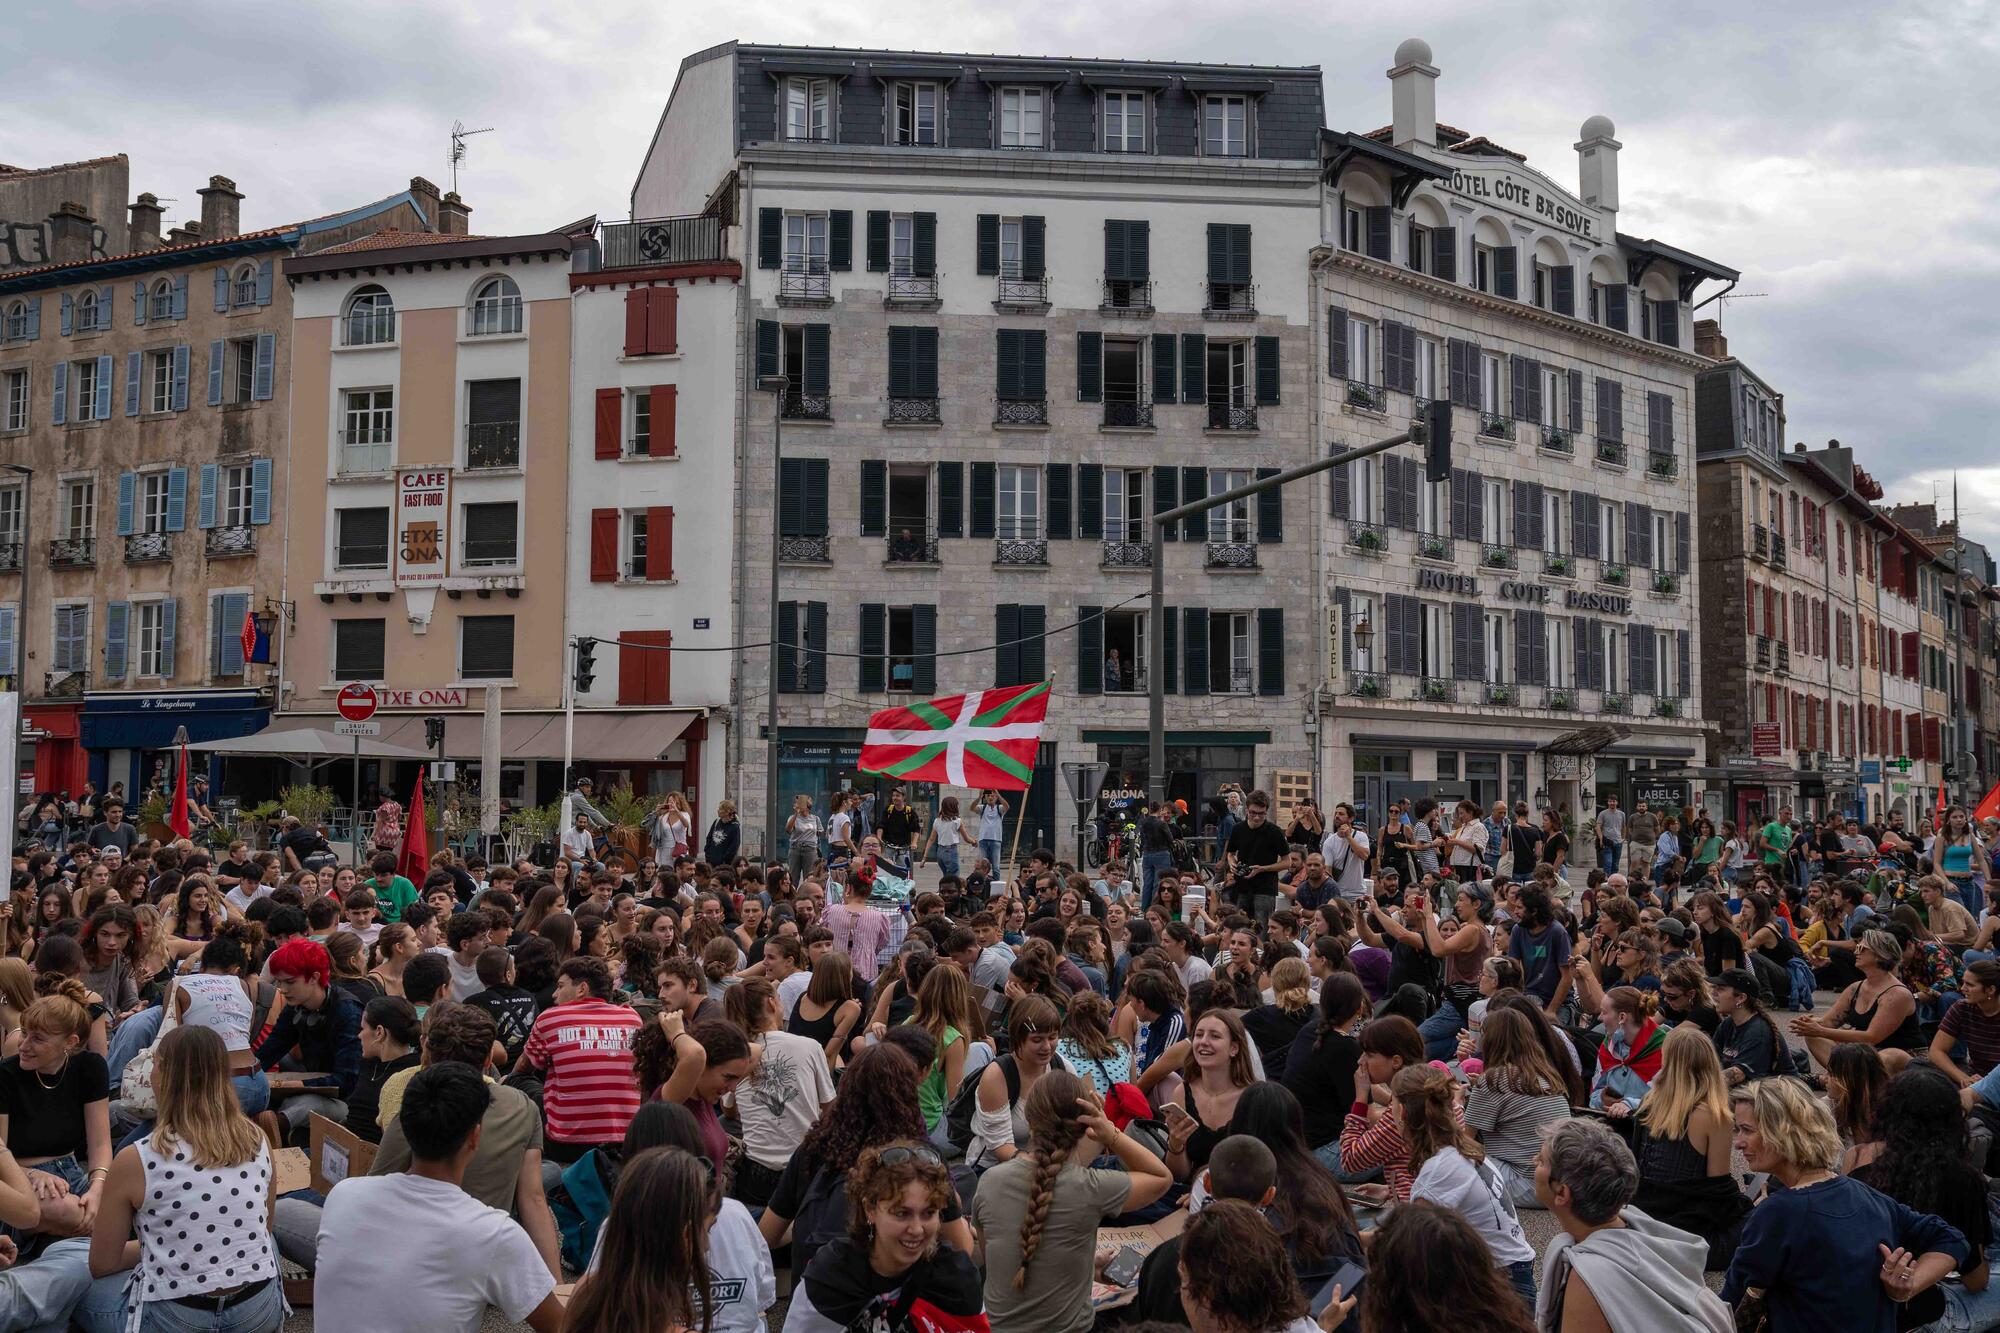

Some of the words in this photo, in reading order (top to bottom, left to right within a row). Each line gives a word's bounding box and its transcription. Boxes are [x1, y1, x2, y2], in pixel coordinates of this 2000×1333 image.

[1495, 176, 1530, 207] CÔTE
[403, 473, 445, 487] CAFE
[404, 493, 422, 508] FAST
[424, 492, 443, 506] FOOD
[401, 529, 443, 543] ETXE
[401, 548, 443, 561] ONA
[1419, 568, 1483, 597] HOTEL
[1501, 581, 1550, 604] COTE
[1566, 590, 1632, 615] BASQUE
[140, 699, 150, 708] Le
[155, 699, 196, 709] Longchamp
[378, 691, 412, 705] TXE
[418, 691, 462, 705] ONA
[1102, 790, 1145, 799] BAIONA
[1637, 789, 1671, 800] LABEL
[1108, 797, 1127, 808] Bike
[558, 1027, 581, 1043] NOT
[585, 1026, 598, 1040] IN
[602, 1027, 623, 1040] THE
[580, 1040, 594, 1050] TRY
[597, 1040, 621, 1050] AGAIN
